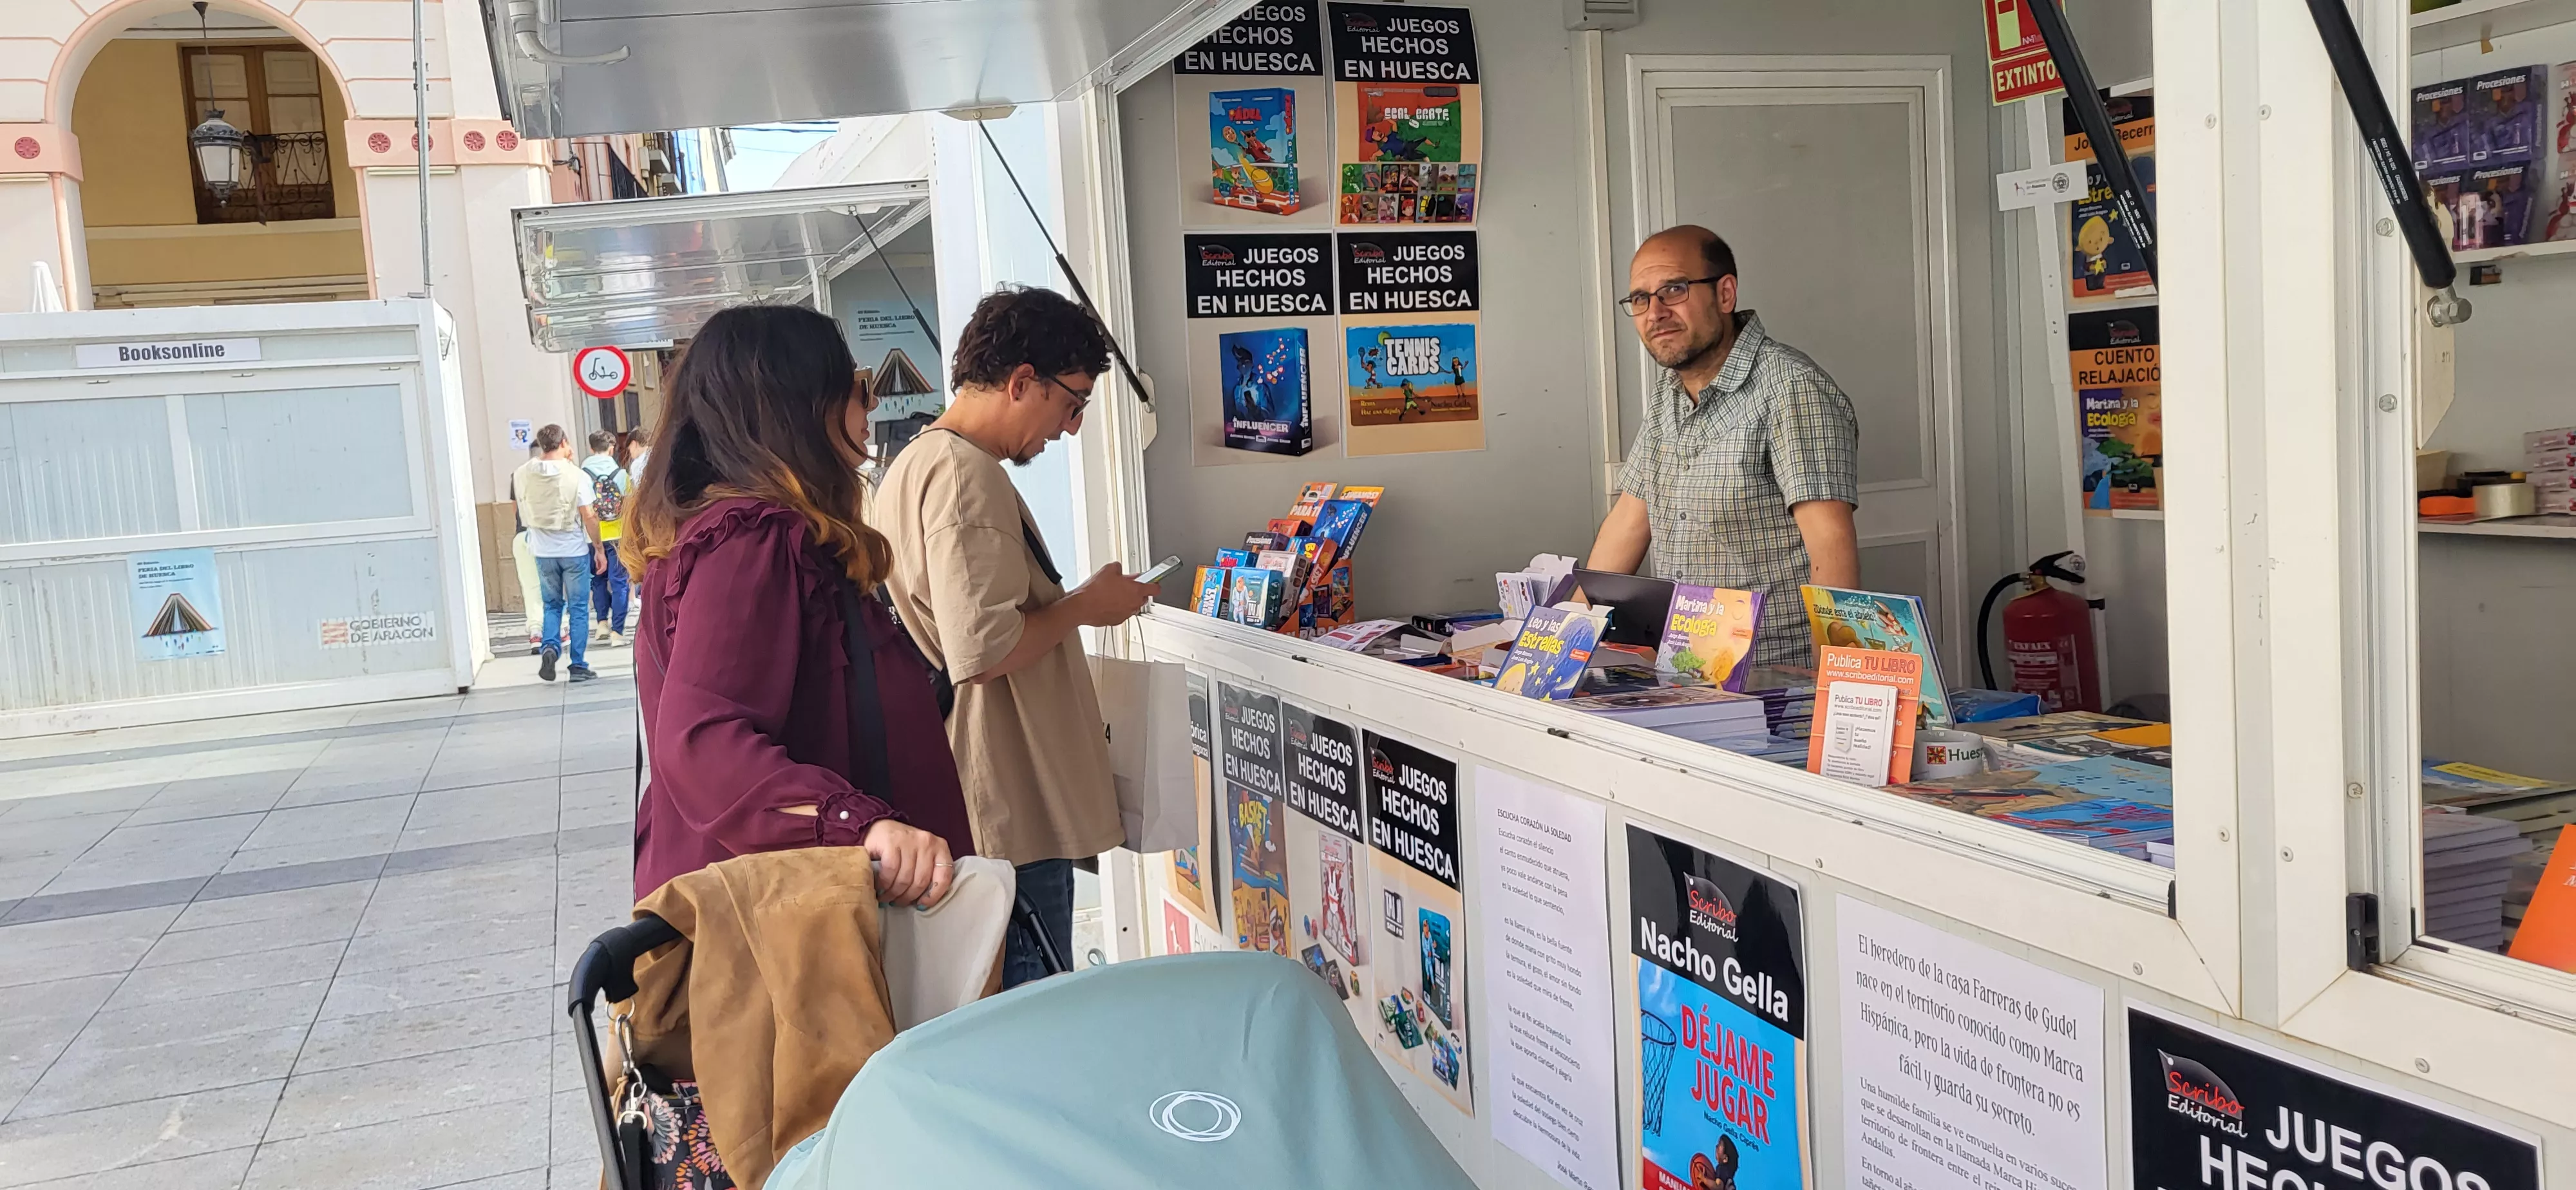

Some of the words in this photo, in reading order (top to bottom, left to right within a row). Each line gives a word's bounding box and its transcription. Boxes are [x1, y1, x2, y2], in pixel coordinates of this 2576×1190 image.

[1233, 6, 1305, 22] UEGOS
[1387, 18, 1460, 33] JUEGOS
[1361, 36, 1448, 55] HECHOS
[1185, 52, 1215, 70] EN
[1224, 52, 1315, 71] HUESCA
[1345, 60, 1374, 78] EN
[1381, 61, 1471, 80] HUESCA
[1996, 59, 2060, 92] EXTINTO
[2477, 73, 2526, 90] Procesiones
[2416, 86, 2463, 102] Procesiones
[1243, 247, 1319, 265] JUEGOS
[1393, 245, 1466, 261] JUEGOS
[1217, 269, 1306, 287] HECHOS
[1367, 266, 1453, 284] HECHOS
[1197, 295, 1227, 314] EN
[1235, 293, 1326, 314] HUESCA
[1350, 292, 1378, 311] EN
[1385, 290, 1472, 309] HUESCA
[119, 343, 225, 361] Booksonline
[1385, 337, 1440, 358] TENNIS
[2094, 348, 2154, 365] CUENTO
[1387, 355, 1439, 375] CARDS
[2079, 364, 2161, 385] RELAJACIÓ
[2087, 398, 2121, 410] Martina
[2123, 400, 2128, 409] y
[2131, 398, 2138, 408] la
[1675, 595, 1707, 613] Martina
[1707, 603, 1715, 615] y
[1716, 602, 1724, 615] la
[350, 616, 421, 630] GOBIERNO
[1528, 616, 1542, 629] Leo
[1540, 621, 1549, 631] y
[1548, 619, 1560, 632] las
[351, 632, 369, 643] DE
[1519, 630, 1564, 654] Estrellas
[1827, 653, 1861, 668] Publica
[1864, 656, 1879, 670] TU
[1881, 658, 1915, 674] LIBRO
[1826, 670, 1913, 684] www.scriboeditorial.com
[1835, 694, 1853, 703] Publica
[1864, 697, 1882, 706] LIBRO
[1242, 706, 1275, 734] JUEGOS
[1191, 721, 1207, 743] órica
[1231, 726, 1270, 759] HECHOS
[1311, 732, 1352, 766] JUEGOS
[1948, 747, 1984, 761] Hues
[1226, 753, 1238, 778] EN
[1240, 759, 1282, 796] HUESCA
[1298, 752, 1346, 795] HECHOS
[1372, 769, 1396, 784] Editorial
[1399, 764, 1447, 805] JUEGOS
[1239, 800, 1267, 835] BASKET
[1290, 780, 1305, 809] EN
[1308, 789, 1359, 836] HUESCA
[1381, 786, 1439, 836] HECHOS
[1497, 809, 1519, 822] ESCUCHA
[1520, 817, 1542, 830] CORAZÓN
[1551, 827, 1571, 842] SOLEDAD
[1499, 827, 1515, 840] Escucha
[1372, 817, 1392, 849] EN
[1394, 827, 1455, 883] HUESCA
[1690, 890, 1737, 923] Scribo
[1690, 910, 1738, 942] Editorial
[1641, 916, 1716, 982] Nacho
[1723, 958, 1788, 1022] Gella
[1858, 933, 1868, 955] El
[1870, 938, 1915, 972] heredero
[1918, 958, 1930, 979] de
[1933, 962, 1943, 985] la
[1946, 972, 1969, 996] casa
[1973, 978, 2021, 1019] Farreras
[2024, 1001, 2038, 1024] de
[2041, 1006, 2076, 1040] Gudel
[1856, 970, 1878, 992] nace
[1880, 981, 1892, 1001] en
[1895, 985, 1904, 1003] el
[1907, 988, 1955, 1025] territorio
[1958, 1013, 2005, 1047] conocido
[2009, 1035, 2040, 1062] como
[2043, 1045, 2083, 1082] Marca
[1680, 1004, 1775, 1100] DÉJAME
[1861, 1001, 1911, 1042] Hispánica,
[1914, 1030, 1938, 1053] pero
[1940, 1037, 1950, 1059] la
[1953, 1045, 1977, 1072] vida
[1980, 1056, 1993, 1079] de
[1996, 1062, 2045, 1104] frontera
[2048, 1091, 2063, 1111] no
[2067, 1100, 2079, 1122] es
[1690, 1057, 1771, 1146] JUGAR
[1899, 1053, 1921, 1081] fácil
[1924, 1069, 1931, 1090] y
[1933, 1073, 1972, 1106] guarda
[1975, 1093, 1988, 1113] su
[1991, 1101, 2035, 1136] secreto.
[2169, 1071, 2245, 1115] Scribo
[2167, 1093, 2248, 1138] Editorial
[1860, 1076, 1876, 1094] Una
[1877, 1084, 1910, 1111] humilde
[1911, 1102, 1940, 1127] familia
[1942, 1121, 1951, 1133] se
[1953, 1126, 1964, 1138] ve
[1965, 1133, 2003, 1159] envuelta
[2005, 1153, 2017, 1166] en
[2018, 1159, 2048, 1182] varios
[1860, 1097, 1875, 1111] que
[1876, 1106, 1885, 1116] se
[1886, 1108, 1931, 1141] desarrollan
[1933, 1135, 1943, 1148] en
[1945, 1137, 1954, 1153] la
[1955, 1143, 1991, 1172] llamada
[1993, 1162, 2023, 1190] Marca
[1861, 1131, 1895, 1158] Andalus.
[1861, 1113, 1895, 1140] territorio
[1897, 1133, 1908, 1146] de
[1911, 1138, 1944, 1166] frontera
[1947, 1161, 1969, 1179] entre
[1972, 1173, 1981, 1186] el
[1861, 1155, 1872, 1171] En
[1873, 1164, 1894, 1184] torno
[1894, 1176, 1903, 1190] al
